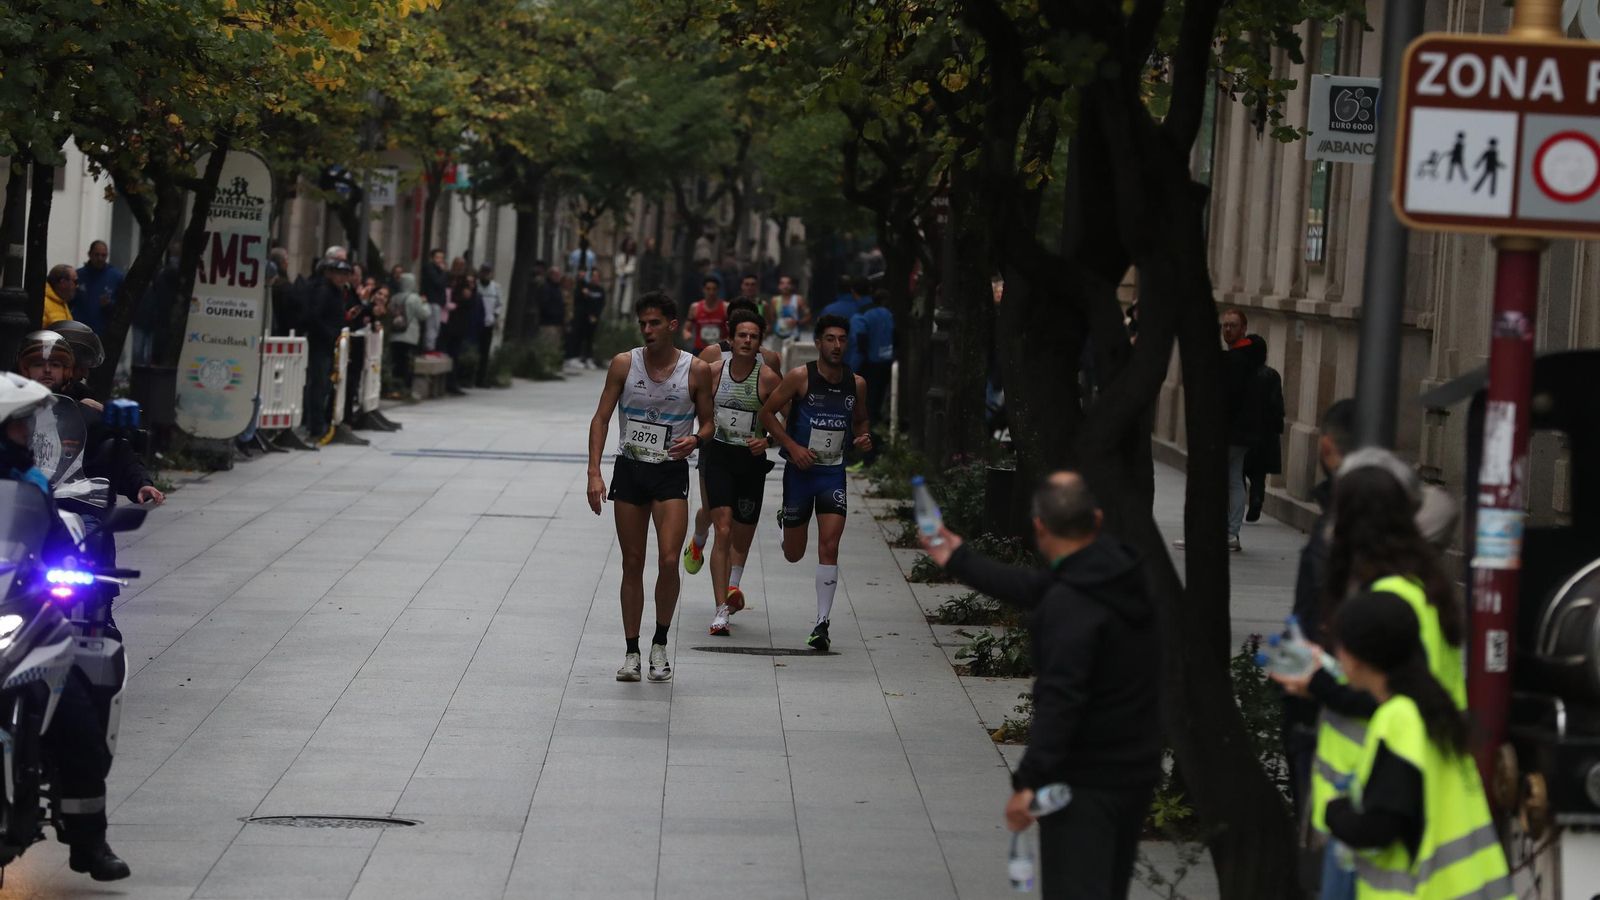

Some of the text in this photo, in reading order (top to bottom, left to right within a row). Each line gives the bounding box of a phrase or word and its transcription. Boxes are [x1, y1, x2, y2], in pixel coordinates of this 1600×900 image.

[1415, 51, 1565, 104] ZONA
[1331, 121, 1374, 132] EURO 6000
[206, 297, 237, 307] Concello
[206, 306, 255, 319] OURENSE
[202, 333, 247, 347] CaixaBank
[730, 416, 737, 427] 2
[631, 430, 658, 444] 2878
[825, 438, 832, 448] 3
